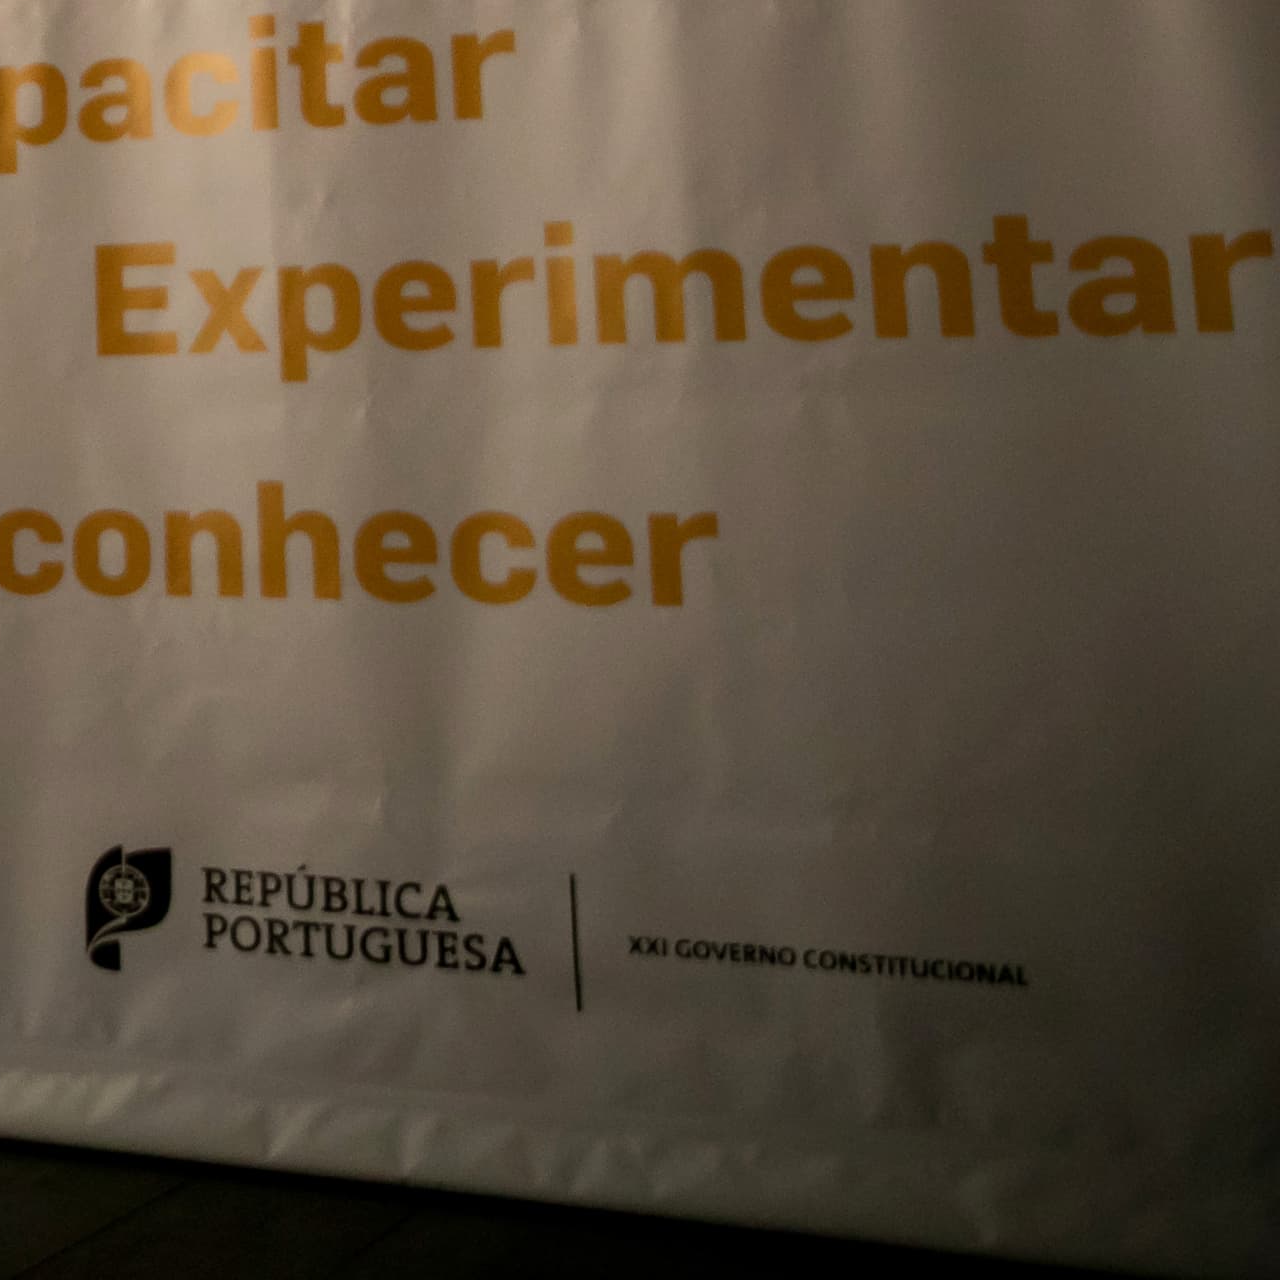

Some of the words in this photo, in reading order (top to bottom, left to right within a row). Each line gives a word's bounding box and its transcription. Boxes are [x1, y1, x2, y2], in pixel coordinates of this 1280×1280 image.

[95, 213, 1273, 383] Experimentar
[202, 864, 460, 923] REPÚBLICA
[202, 913, 526, 976] PORTUGUESA
[628, 935, 668, 958] XXI
[674, 939, 798, 967] GOVERNO
[802, 948, 1028, 987] CONSTITUCIONAL
